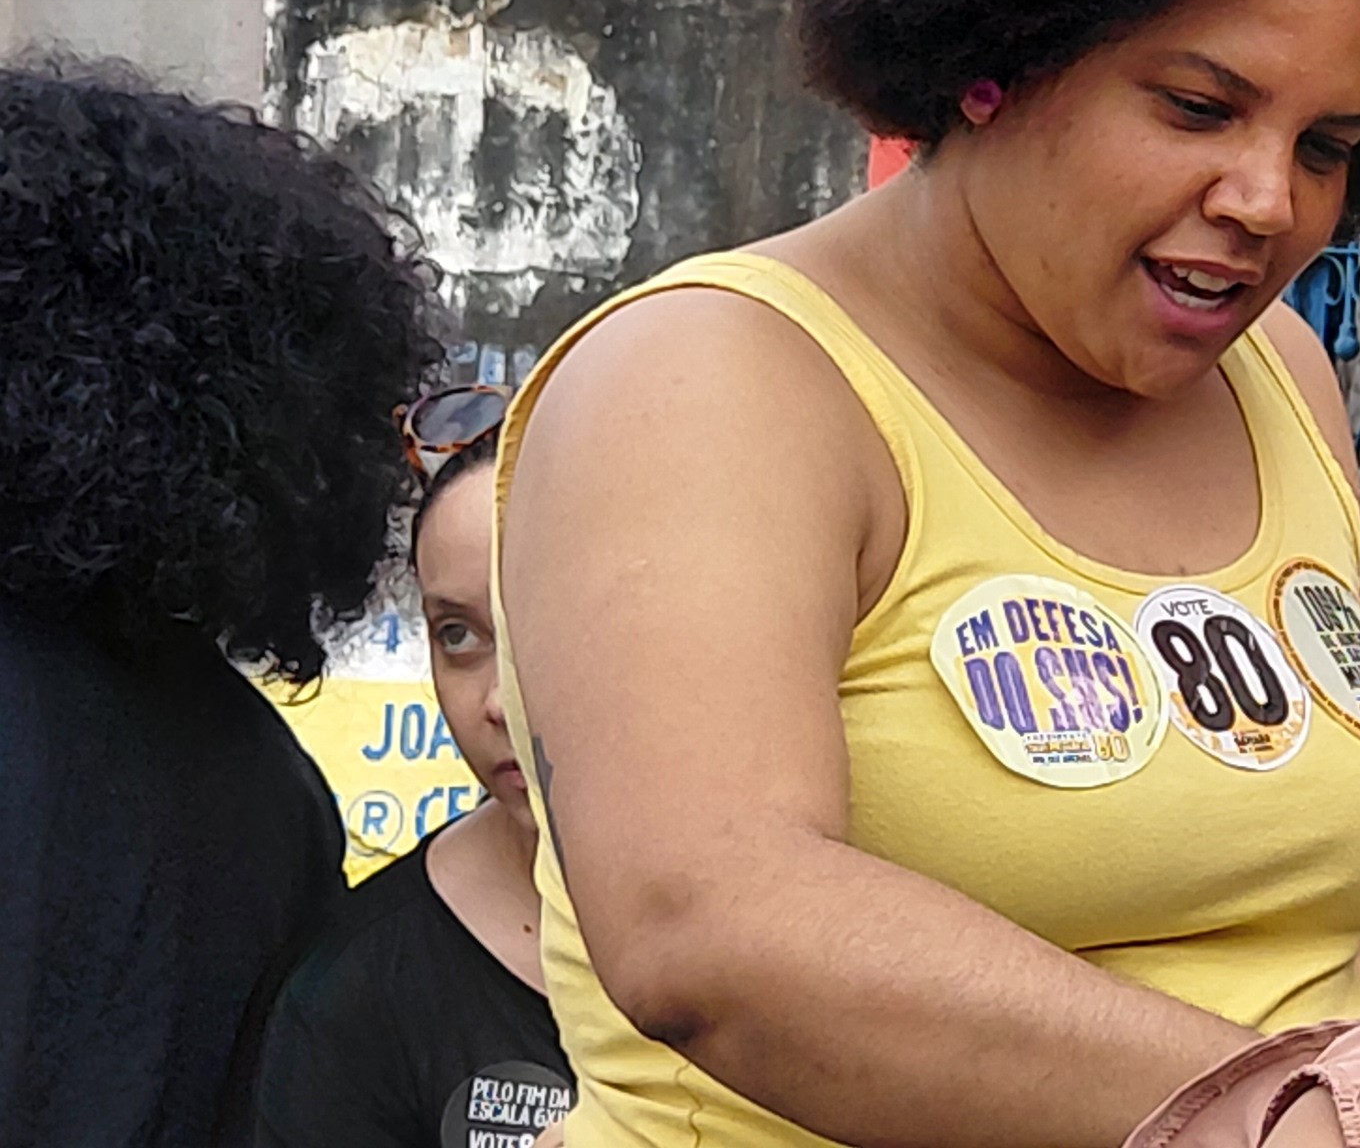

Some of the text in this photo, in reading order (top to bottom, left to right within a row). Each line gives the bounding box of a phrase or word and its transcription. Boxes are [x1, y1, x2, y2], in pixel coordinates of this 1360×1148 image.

[955, 596, 1123, 658] EM DEFESA
[1160, 598, 1214, 618] VOTE
[963, 650, 1041, 737] DO
[1151, 614, 1289, 732] 80
[415, 786, 487, 840] CE
[467, 1099, 530, 1126] ESCALA
[471, 1076, 570, 1110] PELO FIM DA
